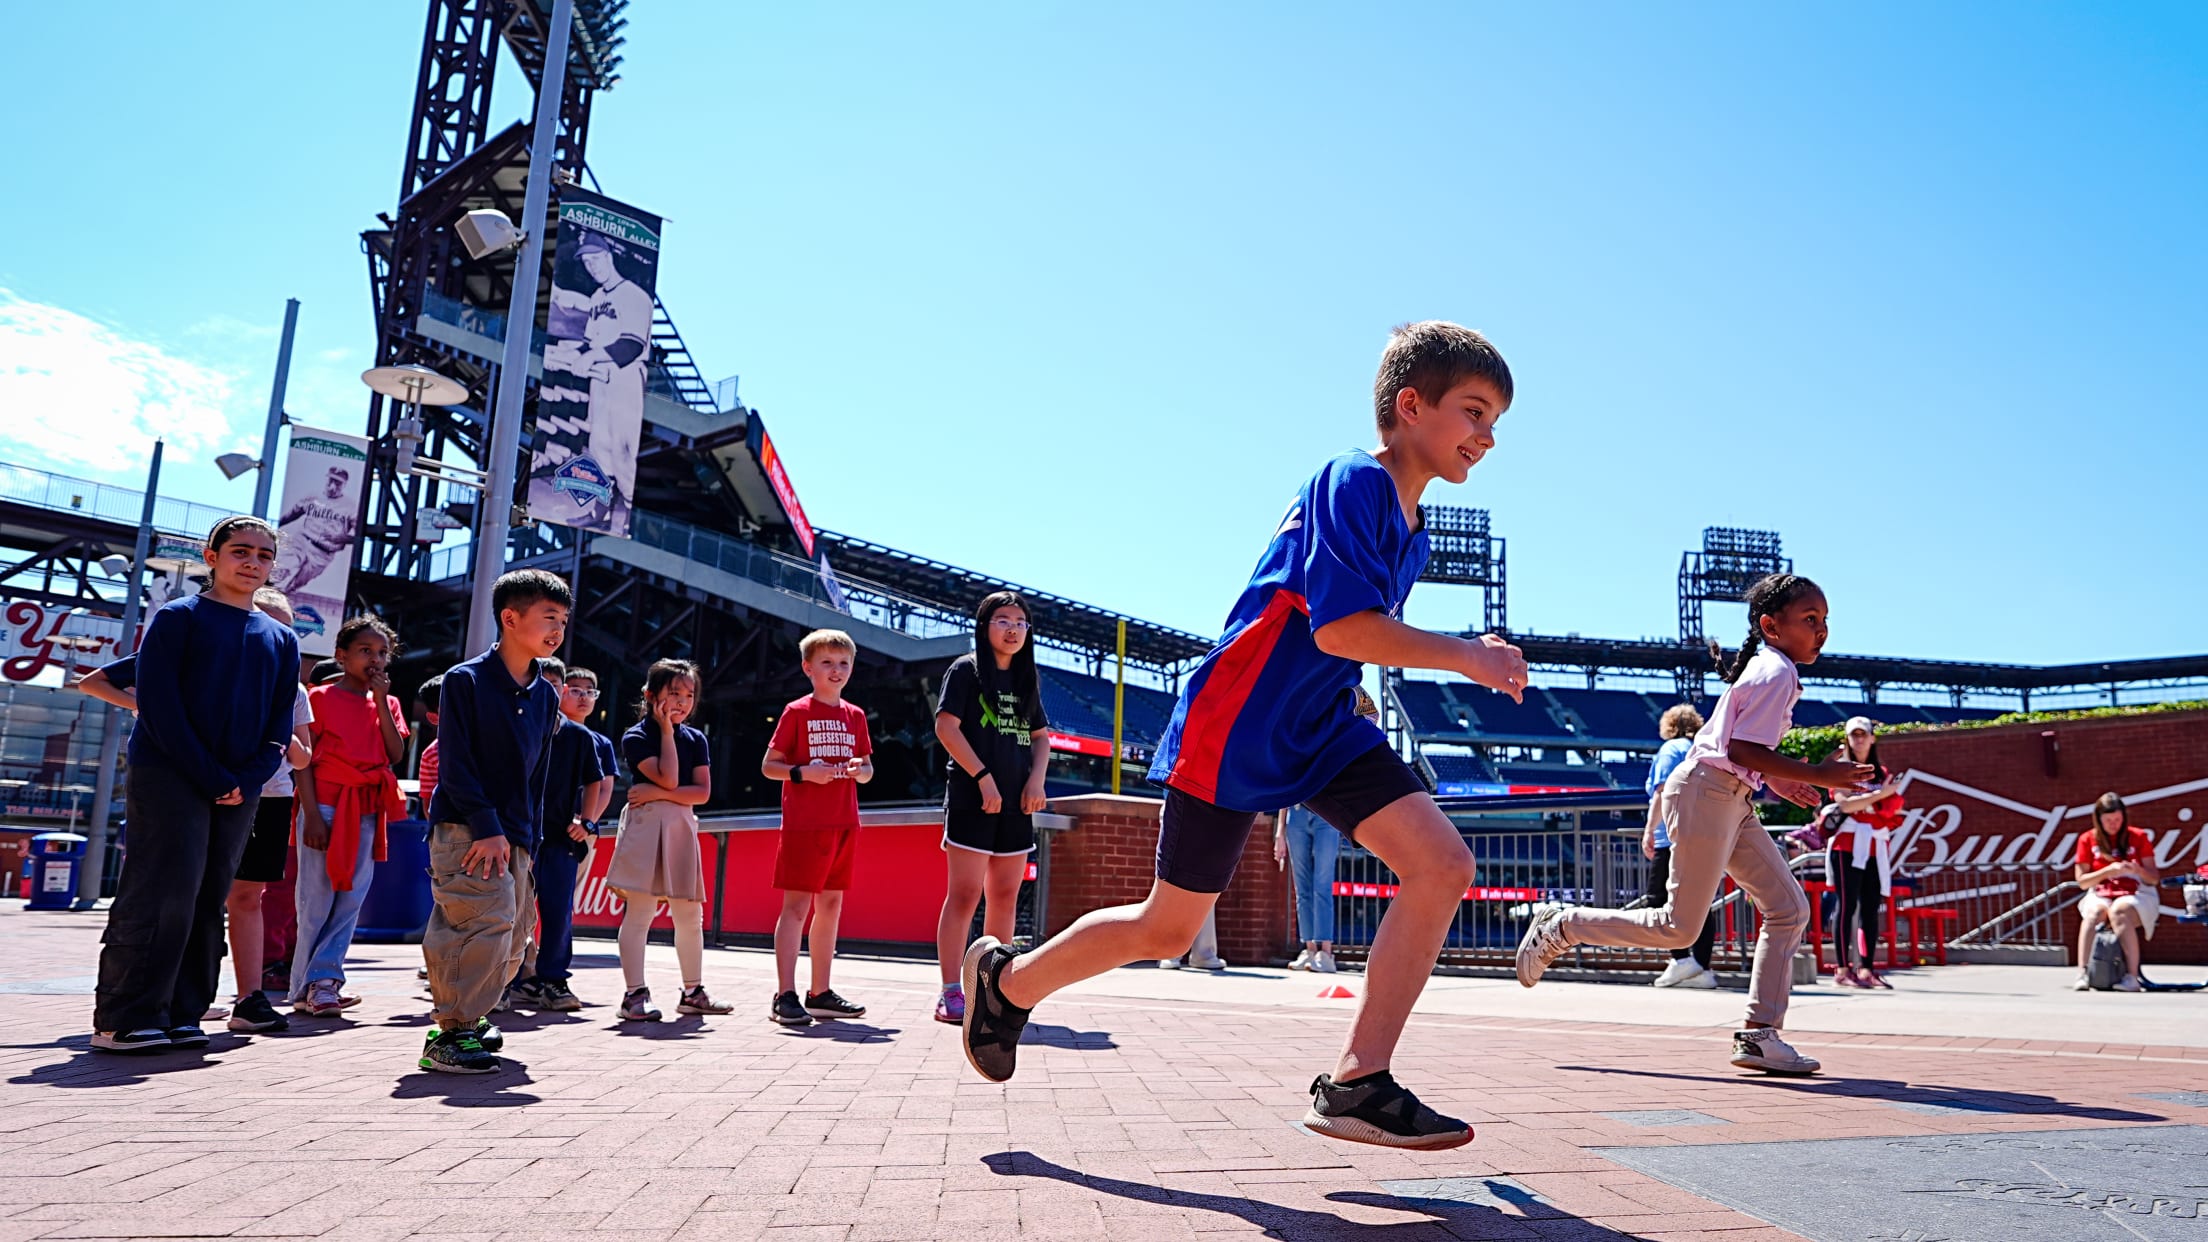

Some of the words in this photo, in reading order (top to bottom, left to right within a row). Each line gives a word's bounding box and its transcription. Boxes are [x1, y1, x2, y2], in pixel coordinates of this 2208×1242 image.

[566, 207, 627, 239] ASHBURN
[628, 233, 658, 249] ALLEY
[294, 440, 340, 457] ASHBURN
[807, 719, 841, 732] PRETZELS
[808, 744, 840, 758] WOODER
